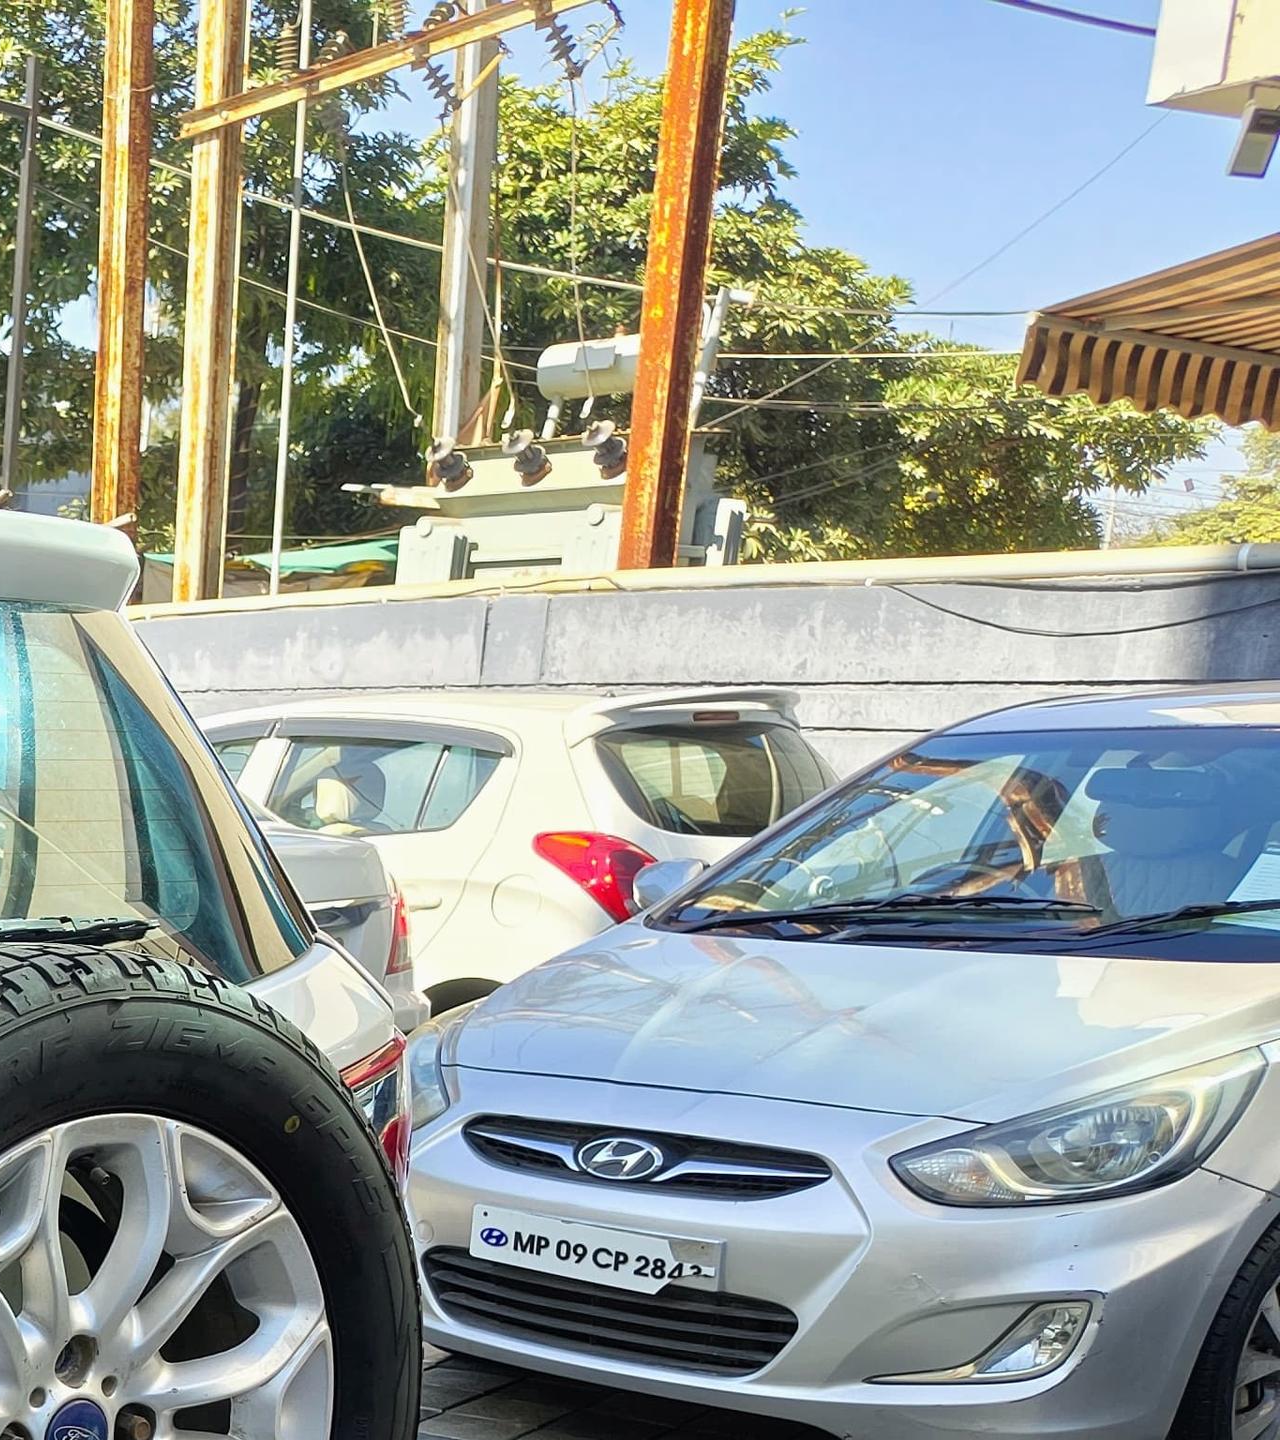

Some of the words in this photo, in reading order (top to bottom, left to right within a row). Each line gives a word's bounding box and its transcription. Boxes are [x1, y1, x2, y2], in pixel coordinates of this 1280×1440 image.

[513, 1231, 550, 1256] MP
[556, 1240, 588, 1264] 09
[592, 1247, 629, 1272] CP
